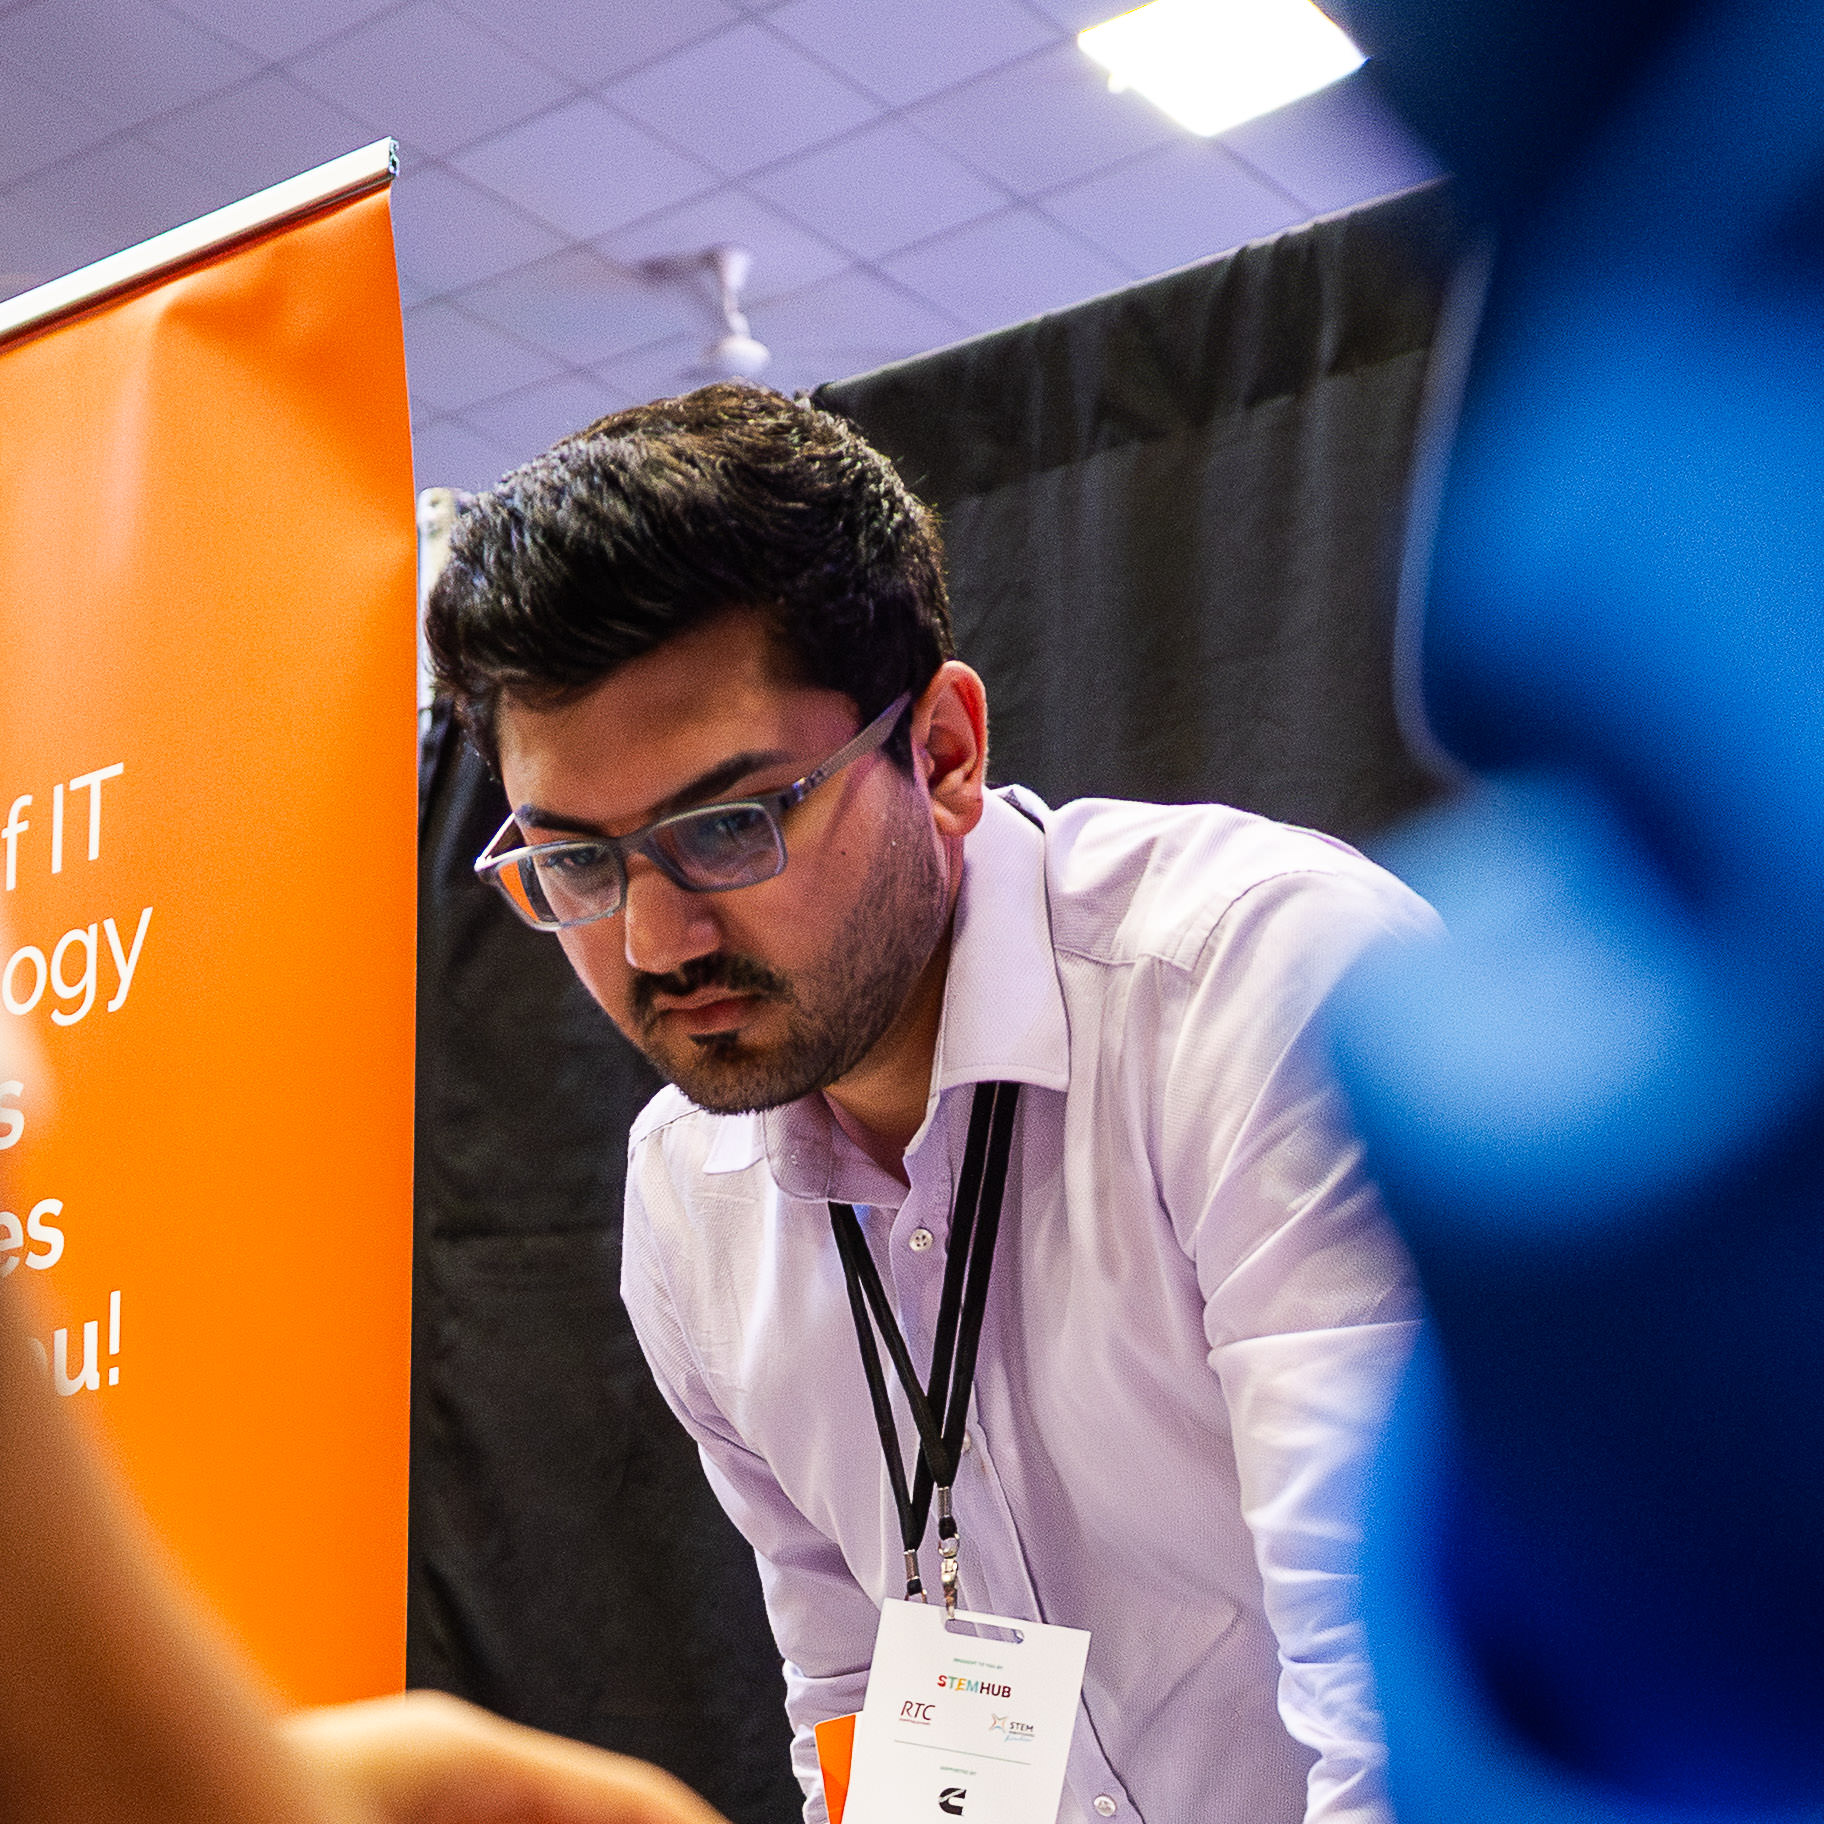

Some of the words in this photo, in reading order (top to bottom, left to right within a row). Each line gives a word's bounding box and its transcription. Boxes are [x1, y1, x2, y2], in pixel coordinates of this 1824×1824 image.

[51, 762, 125, 875] IT
[32, 1290, 122, 1397] u!
[937, 1675, 1012, 1698] STEMHUB
[900, 1700, 936, 1721] RTC
[1009, 1721, 1034, 1733] STEM
